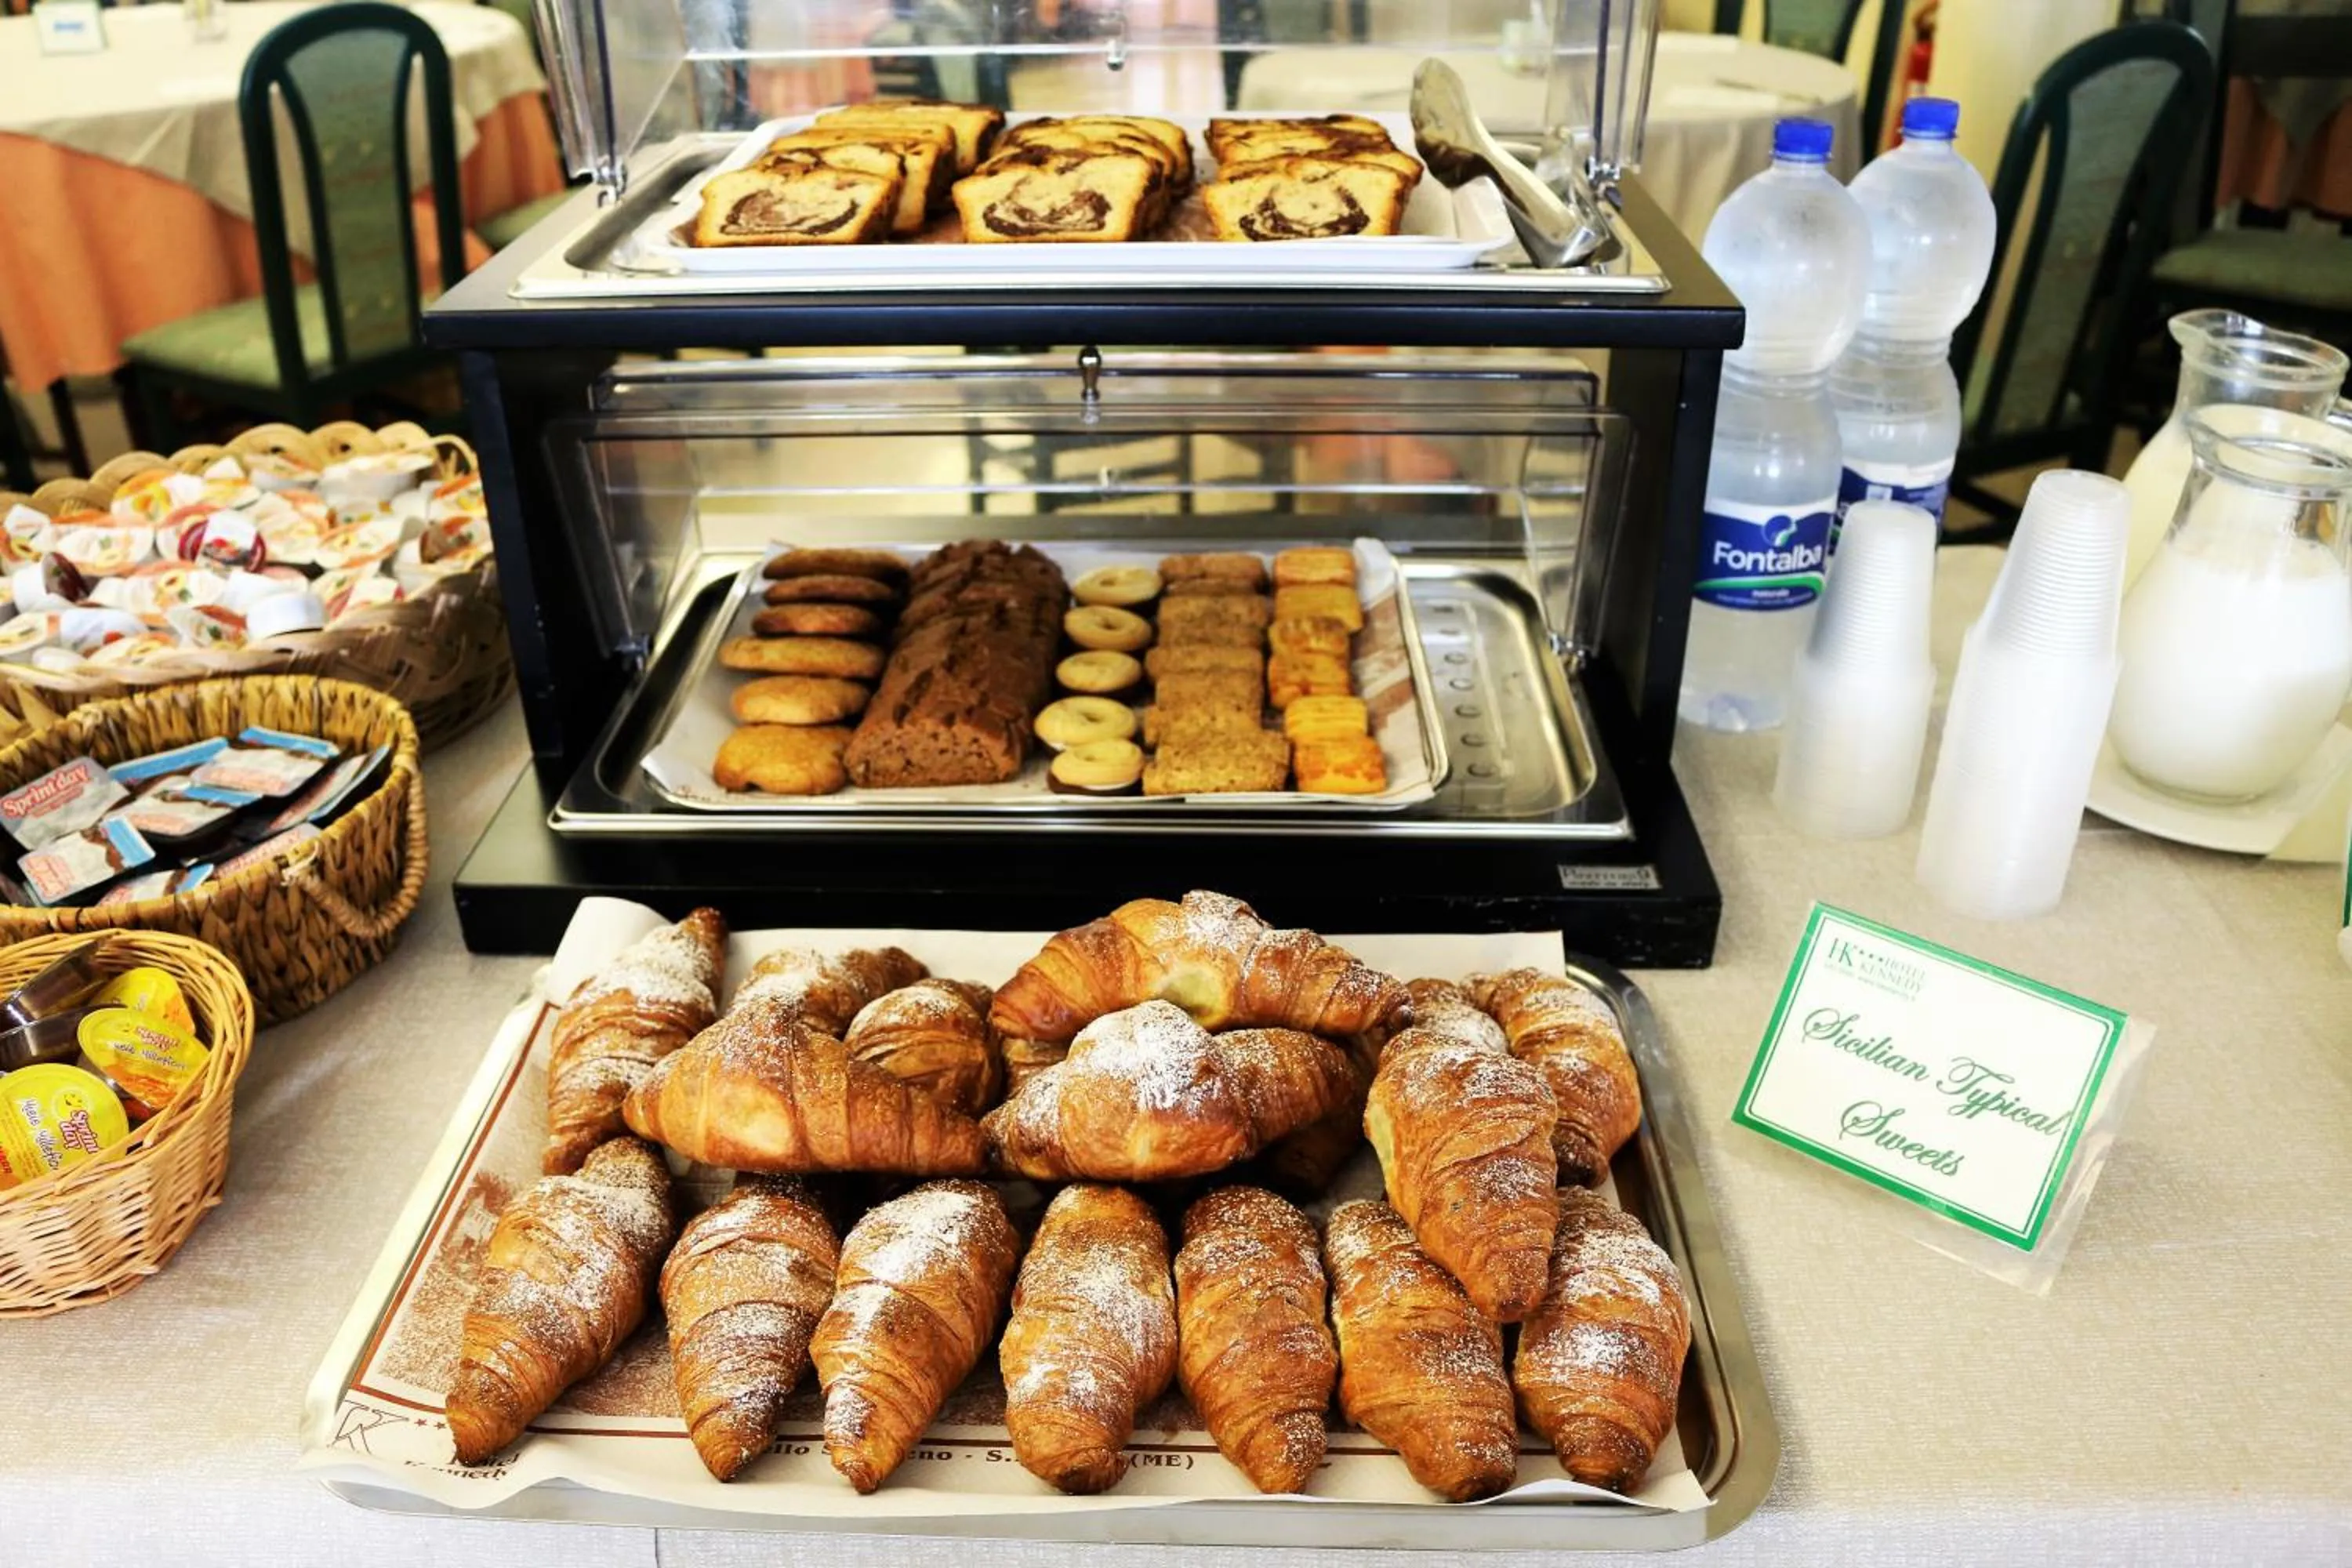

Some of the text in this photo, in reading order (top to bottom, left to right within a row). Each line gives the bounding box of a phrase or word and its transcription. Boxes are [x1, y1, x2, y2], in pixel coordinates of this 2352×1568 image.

[2, 778, 57, 818] Sprint
[55, 765, 88, 789] day
[1802, 1007, 2072, 1135] Sicilian Typical
[1838, 1100, 1965, 1176] Sweets
[1129, 1453, 1195, 1471] (ME)
